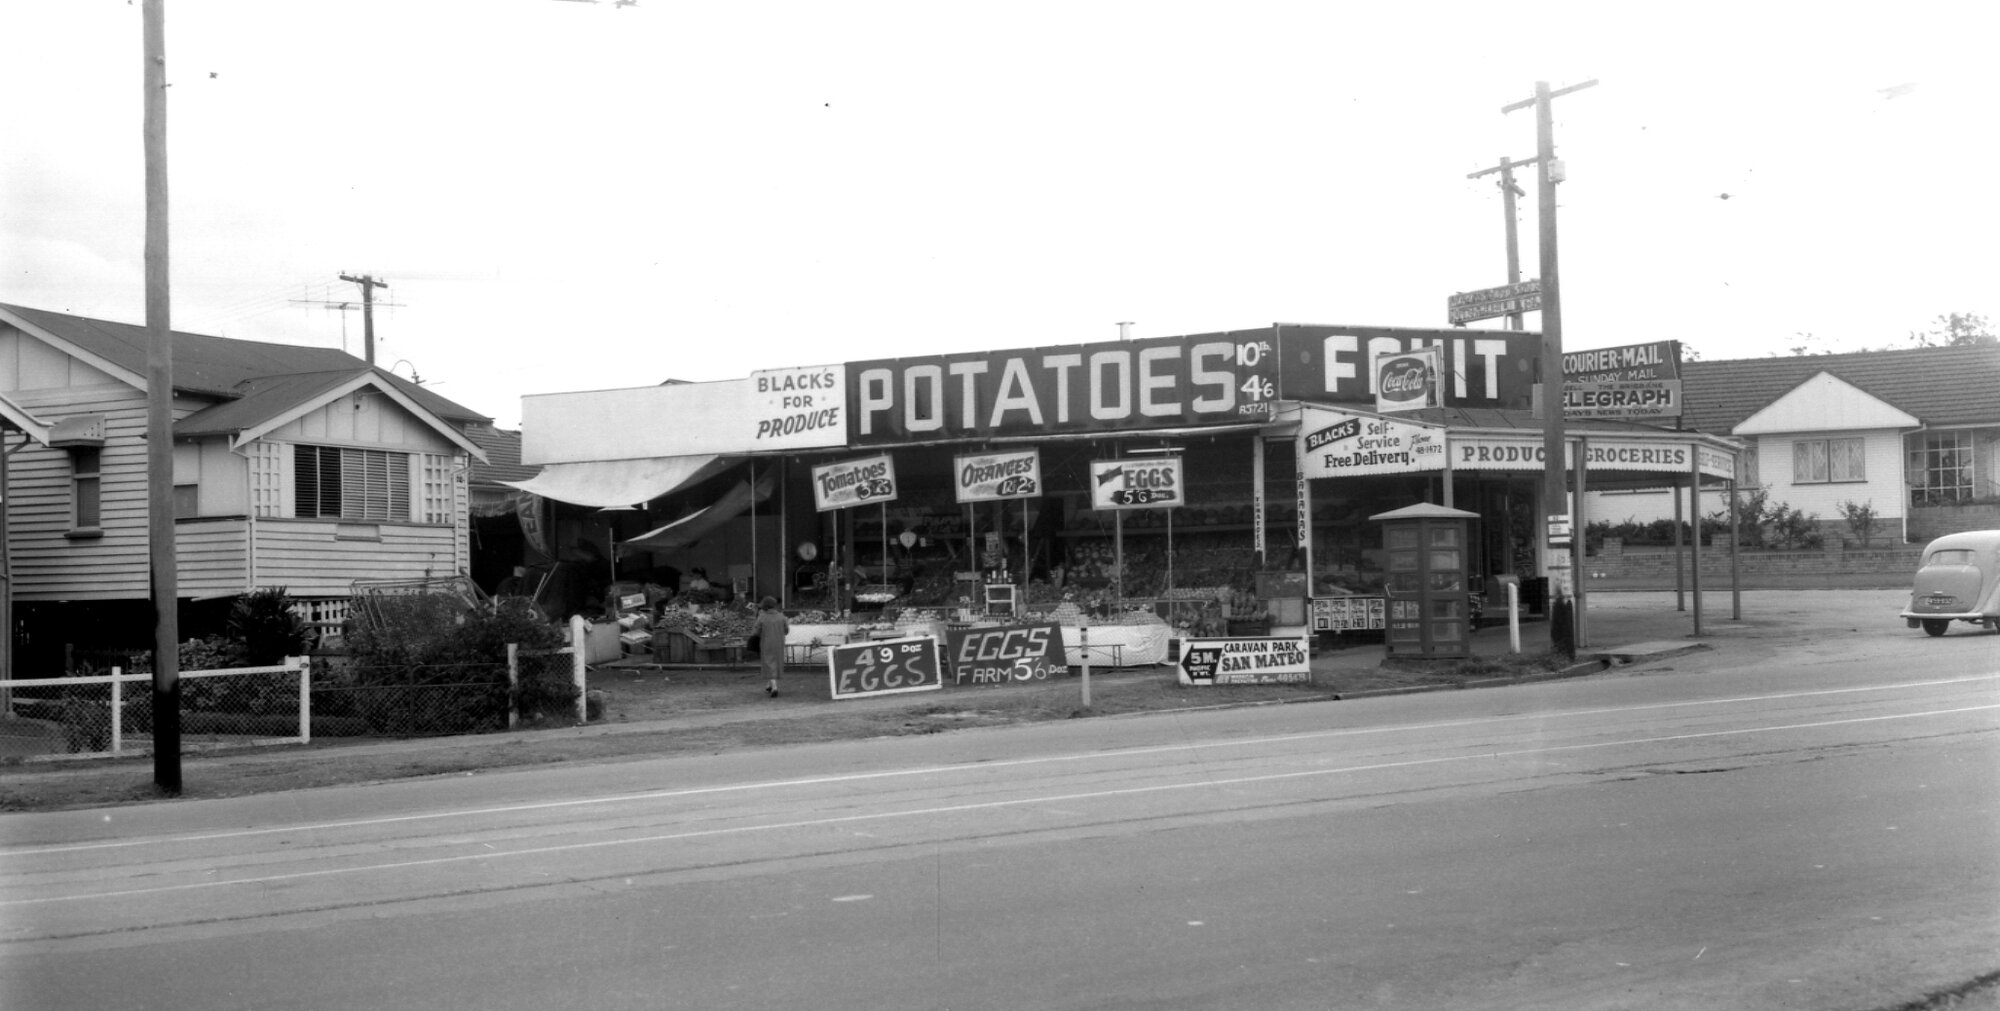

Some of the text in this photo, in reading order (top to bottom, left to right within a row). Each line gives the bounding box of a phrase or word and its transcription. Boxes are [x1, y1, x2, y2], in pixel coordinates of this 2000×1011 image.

[1324, 335, 1507, 399] FRIT
[1578, 368, 1657, 384] SUNDAY MAIL
[758, 368, 835, 392] BLACK'S
[859, 342, 1236, 435] POTATOES
[783, 395, 813, 409] FOR
[1563, 388, 1672, 408] LEGRAPH
[1597, 408, 1621, 416] NEWS
[1627, 407, 1664, 416] TODAY
[756, 407, 840, 439] PRODUCE
[1308, 422, 1354, 448] BLACK'S
[1357, 435, 1400, 449] Service
[1324, 454, 1352, 468] Free
[1462, 446, 1546, 462] PRODUC
[1586, 447, 1686, 465] GROCERIES
[818, 462, 887, 499] Tomatoes
[961, 455, 1035, 488] ORANGES
[1123, 467, 1175, 488] EGGS
[1297, 471, 1305, 541] BANANAS
[959, 627, 1052, 662] EGGS
[1224, 641, 1299, 653] CARAVAN PARK
[1191, 652, 1202, 664] 5
[838, 656, 926, 693] EGGS
[957, 665, 1012, 685] FARM
